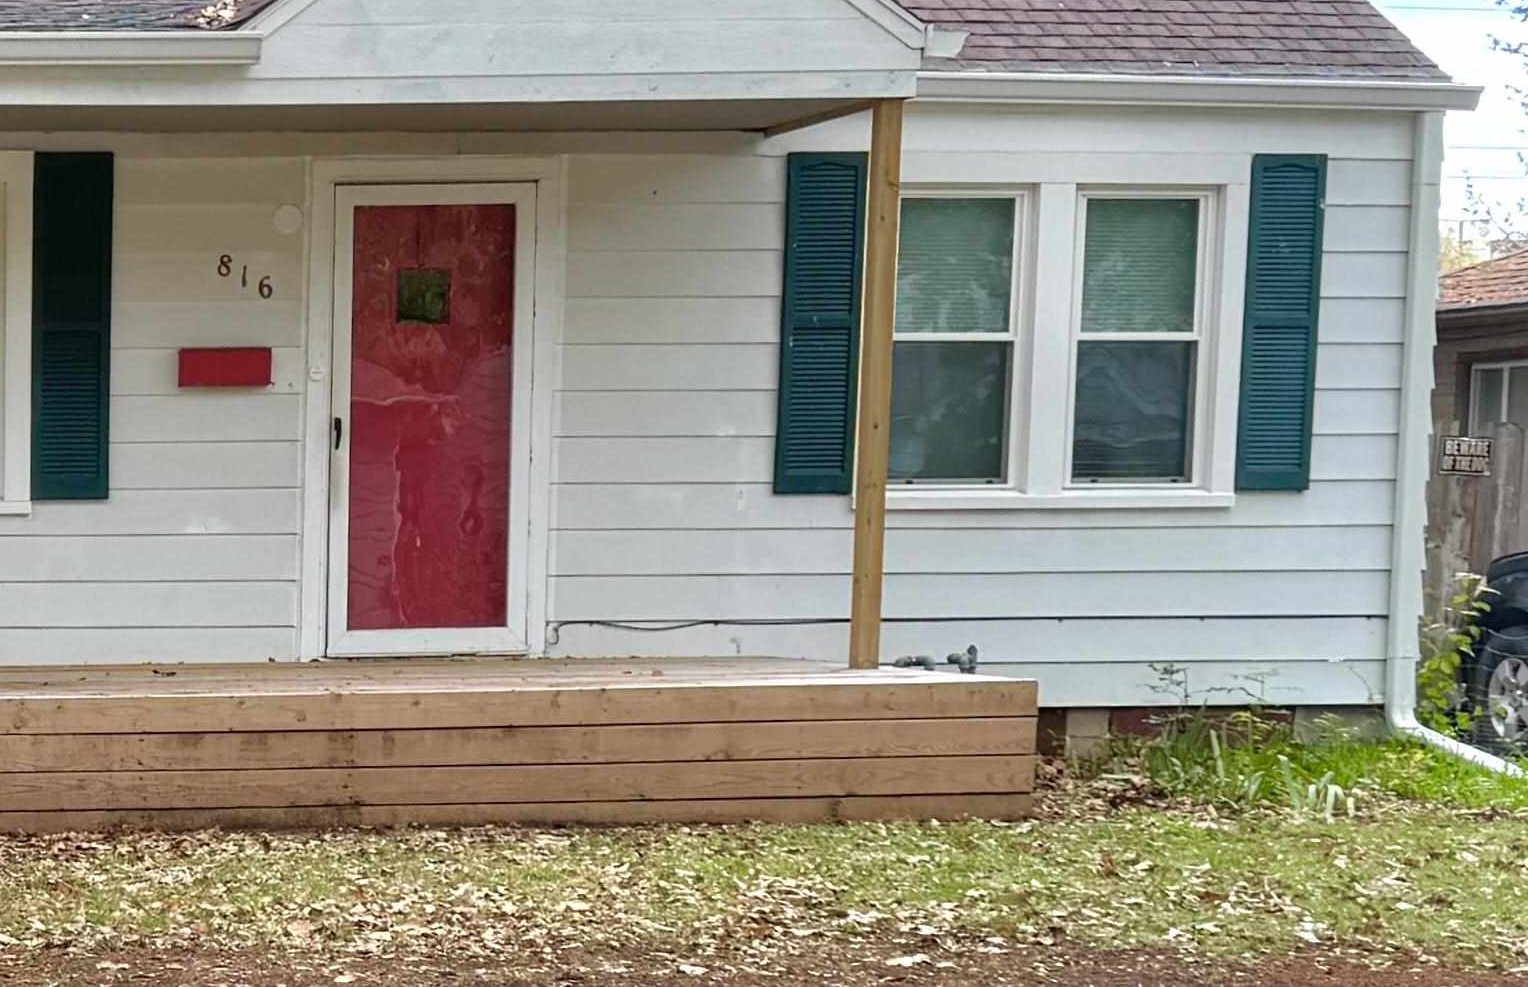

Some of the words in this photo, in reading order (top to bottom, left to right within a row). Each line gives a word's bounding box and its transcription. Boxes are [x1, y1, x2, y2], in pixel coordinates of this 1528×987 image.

[217, 254, 273, 299] 816
[1445, 440, 1489, 456] BEWARE
[1455, 456, 1472, 471] THE
